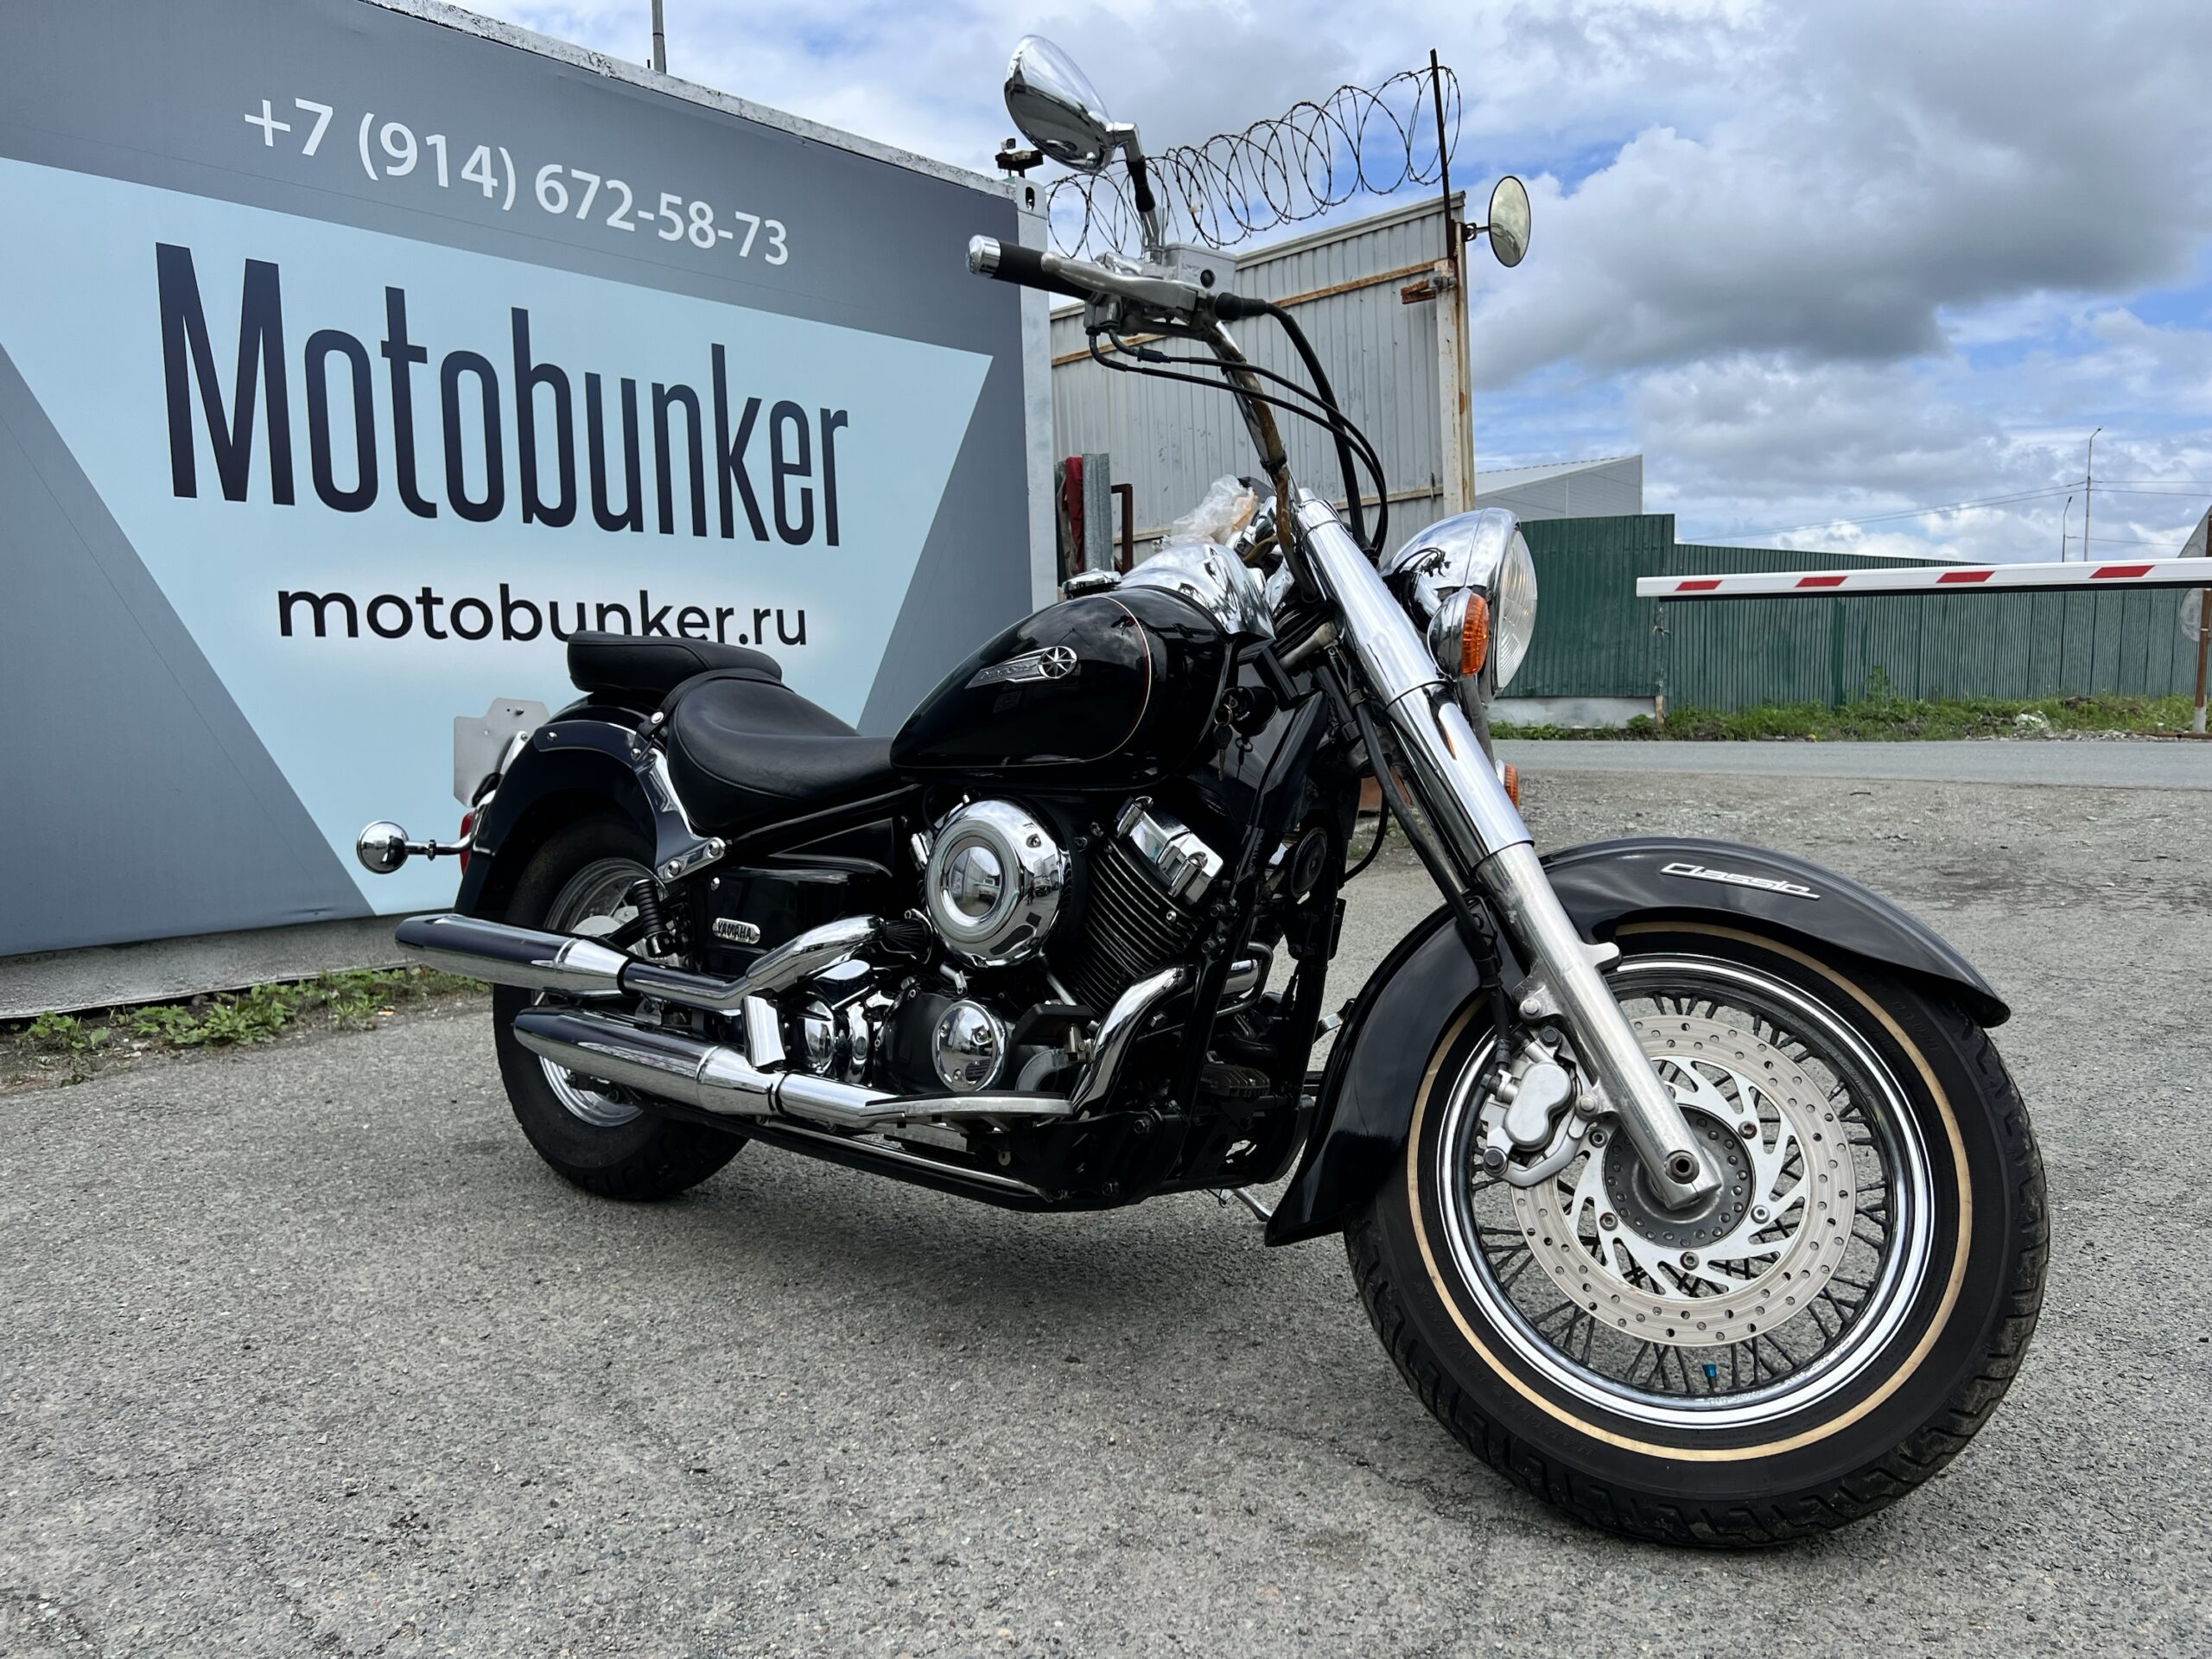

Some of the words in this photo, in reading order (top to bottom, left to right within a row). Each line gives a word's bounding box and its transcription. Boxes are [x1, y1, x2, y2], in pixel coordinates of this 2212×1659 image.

[244, 97, 334, 156] +7
[359, 111, 517, 212] (914)
[534, 163, 790, 265] 672-58-73
[156, 242, 849, 547] Motobunker
[277, 582, 808, 646] motobunker.ru
[1661, 862, 1821, 900] Classic
[715, 919, 755, 942] YAMAHA
